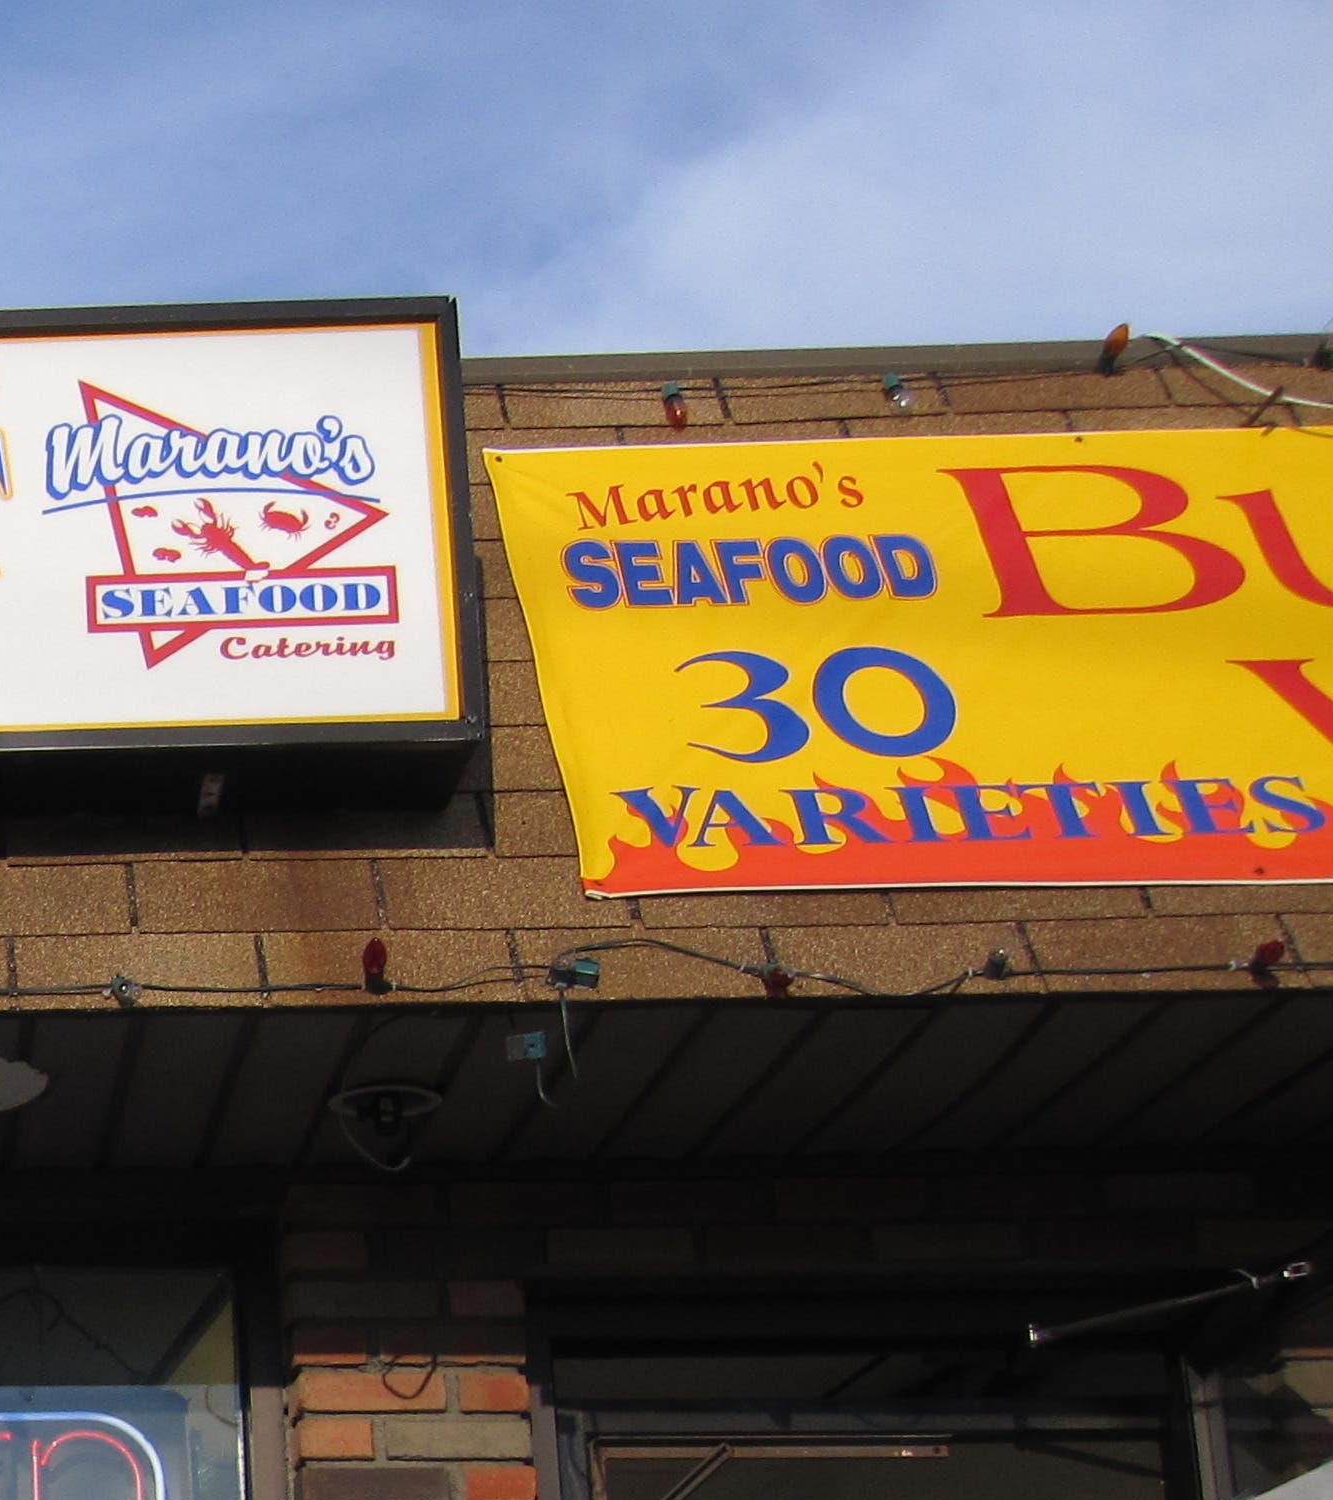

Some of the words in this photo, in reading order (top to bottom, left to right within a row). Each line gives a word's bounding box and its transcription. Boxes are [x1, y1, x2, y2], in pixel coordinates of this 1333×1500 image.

[42, 414, 375, 499] Marano's
[566, 462, 865, 532] Marano's
[101, 582, 382, 620] SEAFOOD
[562, 533, 939, 611] SEAFOOD
[219, 635, 397, 661] Catering
[675, 646, 959, 764] 30
[610, 776, 1326, 849] VARIETIES
